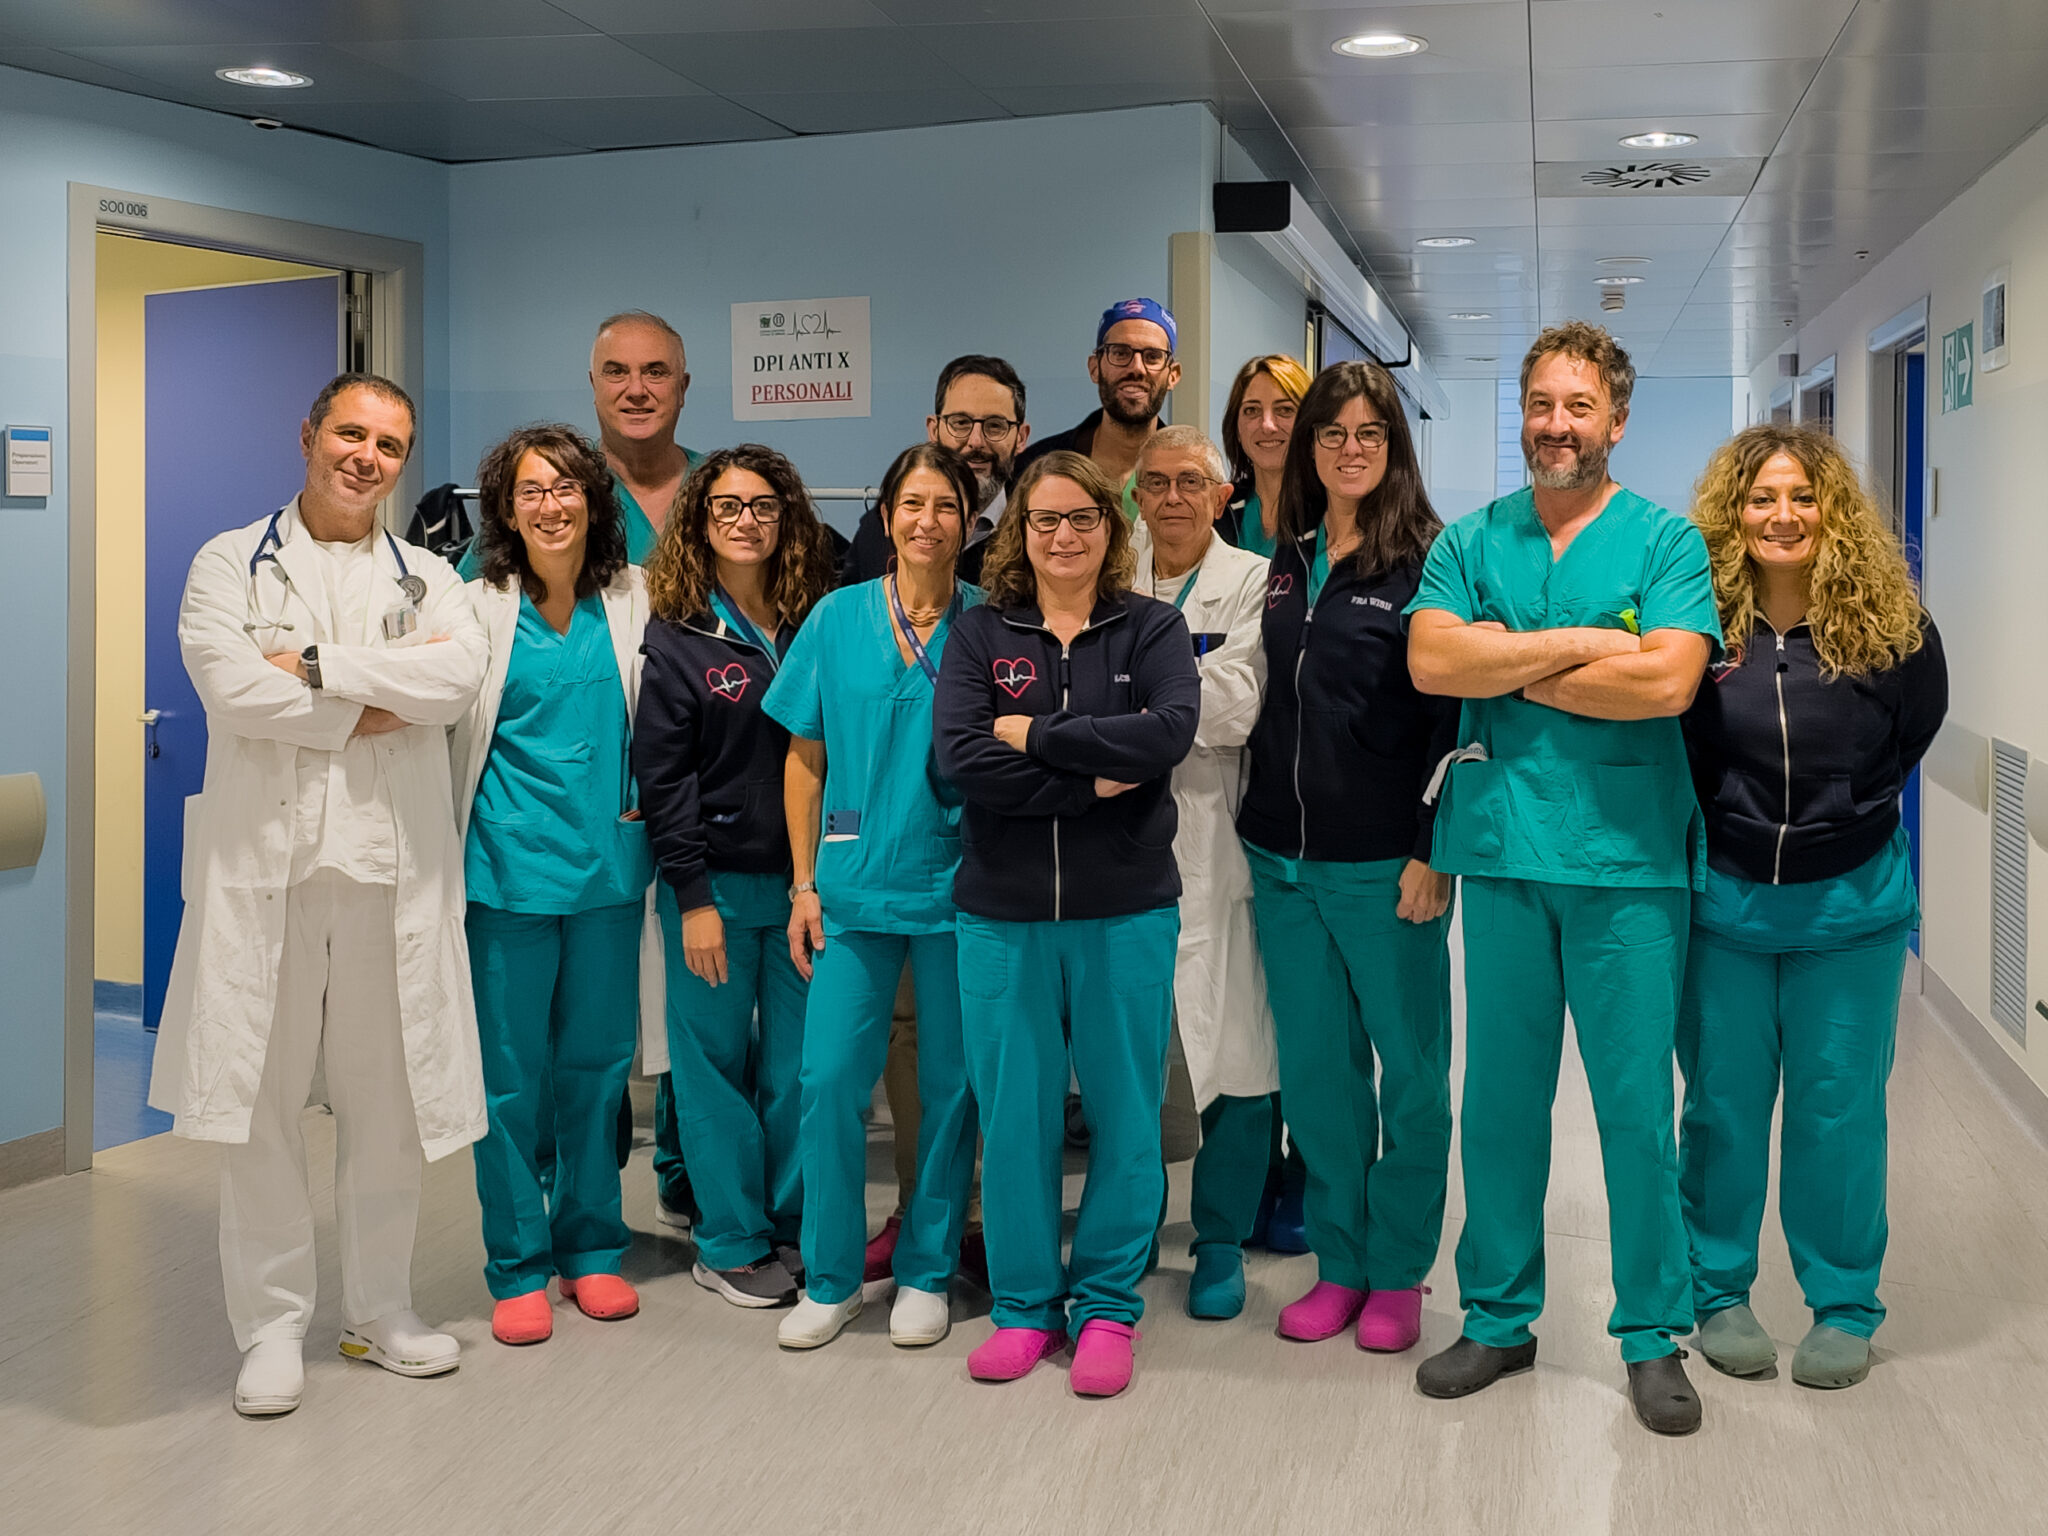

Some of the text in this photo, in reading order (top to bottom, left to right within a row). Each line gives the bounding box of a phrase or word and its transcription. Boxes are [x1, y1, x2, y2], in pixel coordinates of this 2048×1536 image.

[753, 351, 850, 372] DPI ANTI X
[751, 381, 852, 401] PERSONALI
